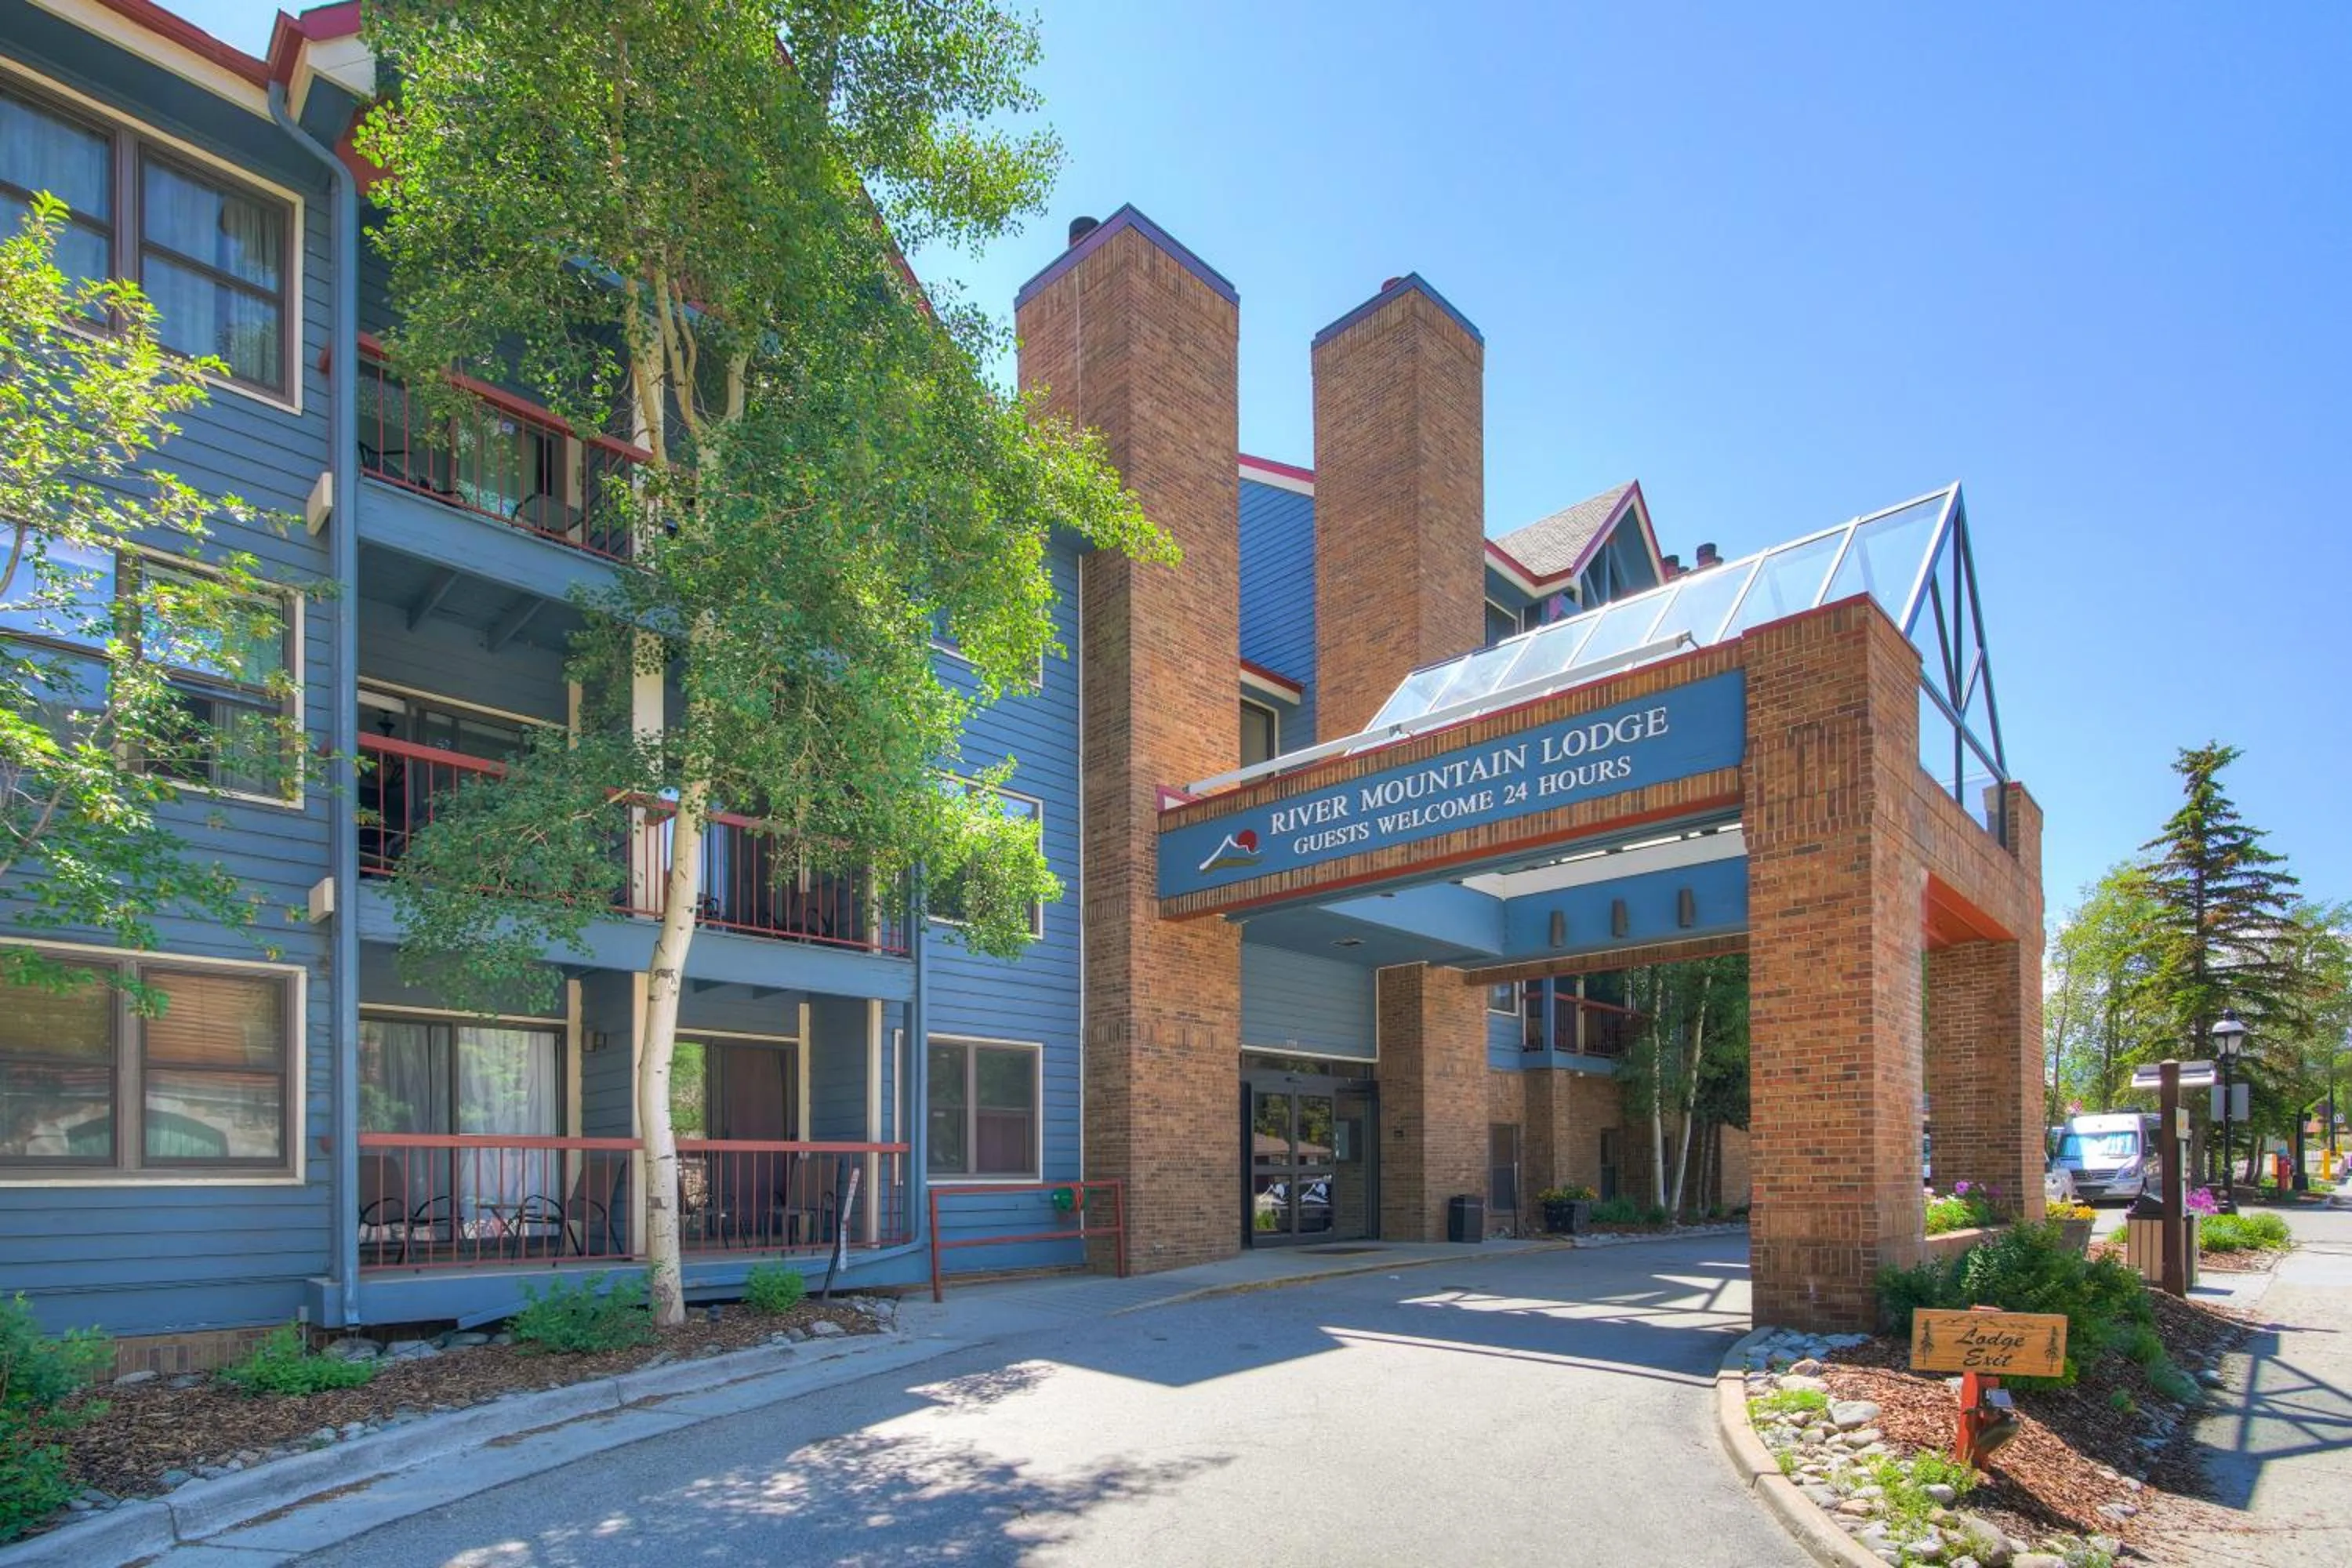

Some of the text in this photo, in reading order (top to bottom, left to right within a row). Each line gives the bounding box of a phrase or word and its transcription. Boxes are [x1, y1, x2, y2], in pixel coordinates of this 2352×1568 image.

[1271, 706, 1668, 834] RIVER MOUNTAIN LODGE
[1294, 755, 1632, 854] GUESTS WELCOME 24 HOURS
[1955, 1328, 2025, 1351] Lodge
[1963, 1348, 2013, 1367] Exit
